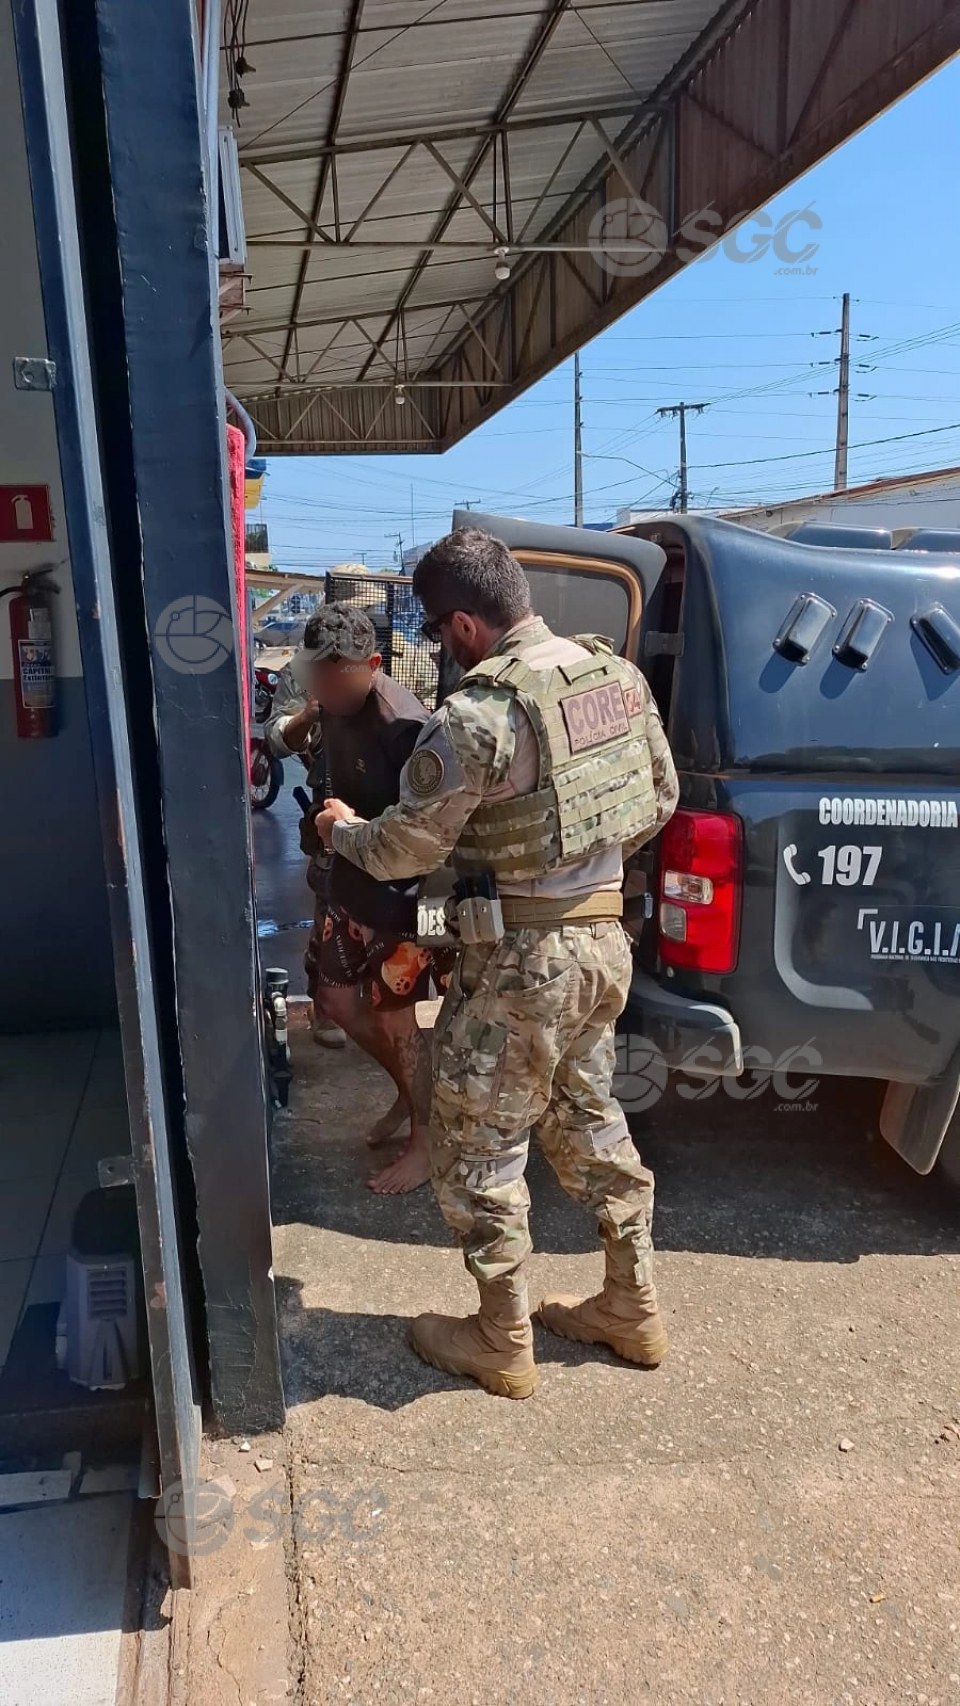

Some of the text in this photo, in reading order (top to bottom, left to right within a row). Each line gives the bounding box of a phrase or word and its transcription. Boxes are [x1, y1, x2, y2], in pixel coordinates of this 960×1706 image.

[567, 685, 625, 735] CORE
[818, 797, 959, 828] COORDENADORIA
[818, 845, 883, 886] 197
